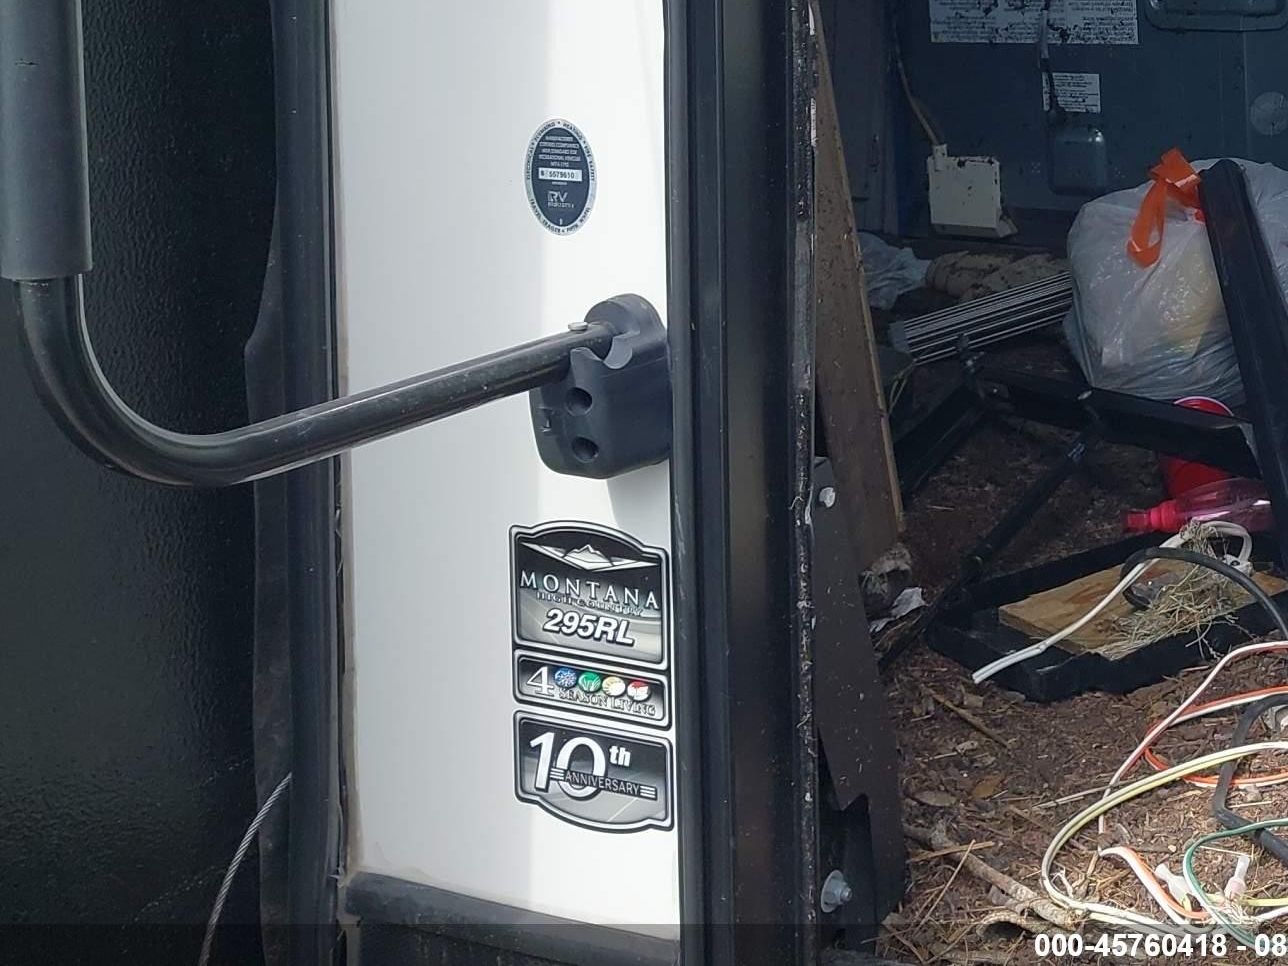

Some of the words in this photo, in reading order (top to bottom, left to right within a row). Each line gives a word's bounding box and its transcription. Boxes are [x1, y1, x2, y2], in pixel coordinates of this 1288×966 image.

[520, 569, 660, 611] MONTANA
[543, 607, 637, 647] 295RL
[526, 665, 555, 698] 4
[557, 687, 609, 707] SEASON
[610, 696, 656, 717] LIVING
[564, 770, 641, 796] ANNIVERSARY
